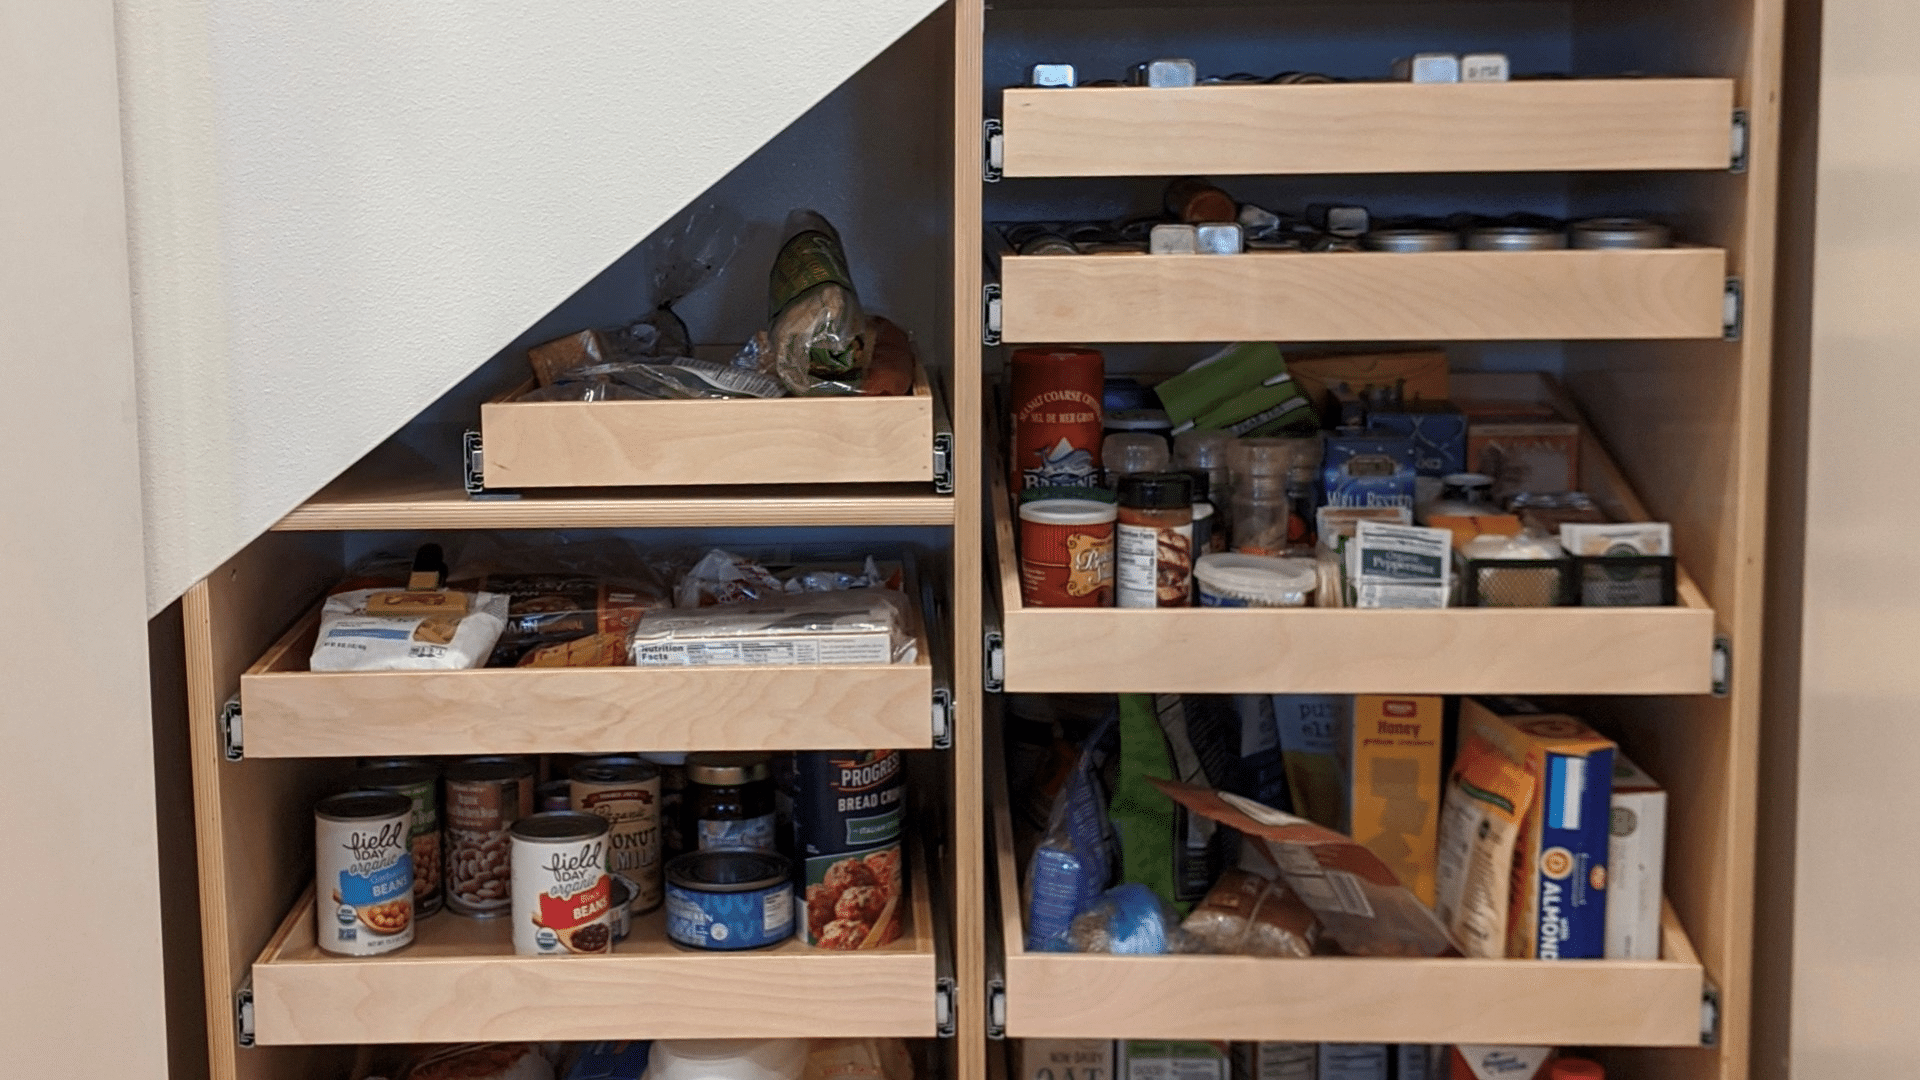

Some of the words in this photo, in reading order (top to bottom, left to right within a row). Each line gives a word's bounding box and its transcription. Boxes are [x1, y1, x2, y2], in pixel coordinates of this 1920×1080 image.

[1044, 389, 1083, 403] COARSE
[1046, 412, 1057, 423] DE
[640, 643, 684, 653] Nutrition
[640, 652, 668, 662] Facts
[1377, 720, 1421, 739] Honey
[837, 792, 879, 812] BREAD
[342, 821, 402, 861] field
[611, 826, 657, 849] ONUT
[361, 849, 386, 861] DAY
[542, 841, 602, 882] field
[350, 854, 398, 877] organic
[561, 869, 587, 881] DAY
[550, 874, 597, 899] organic
